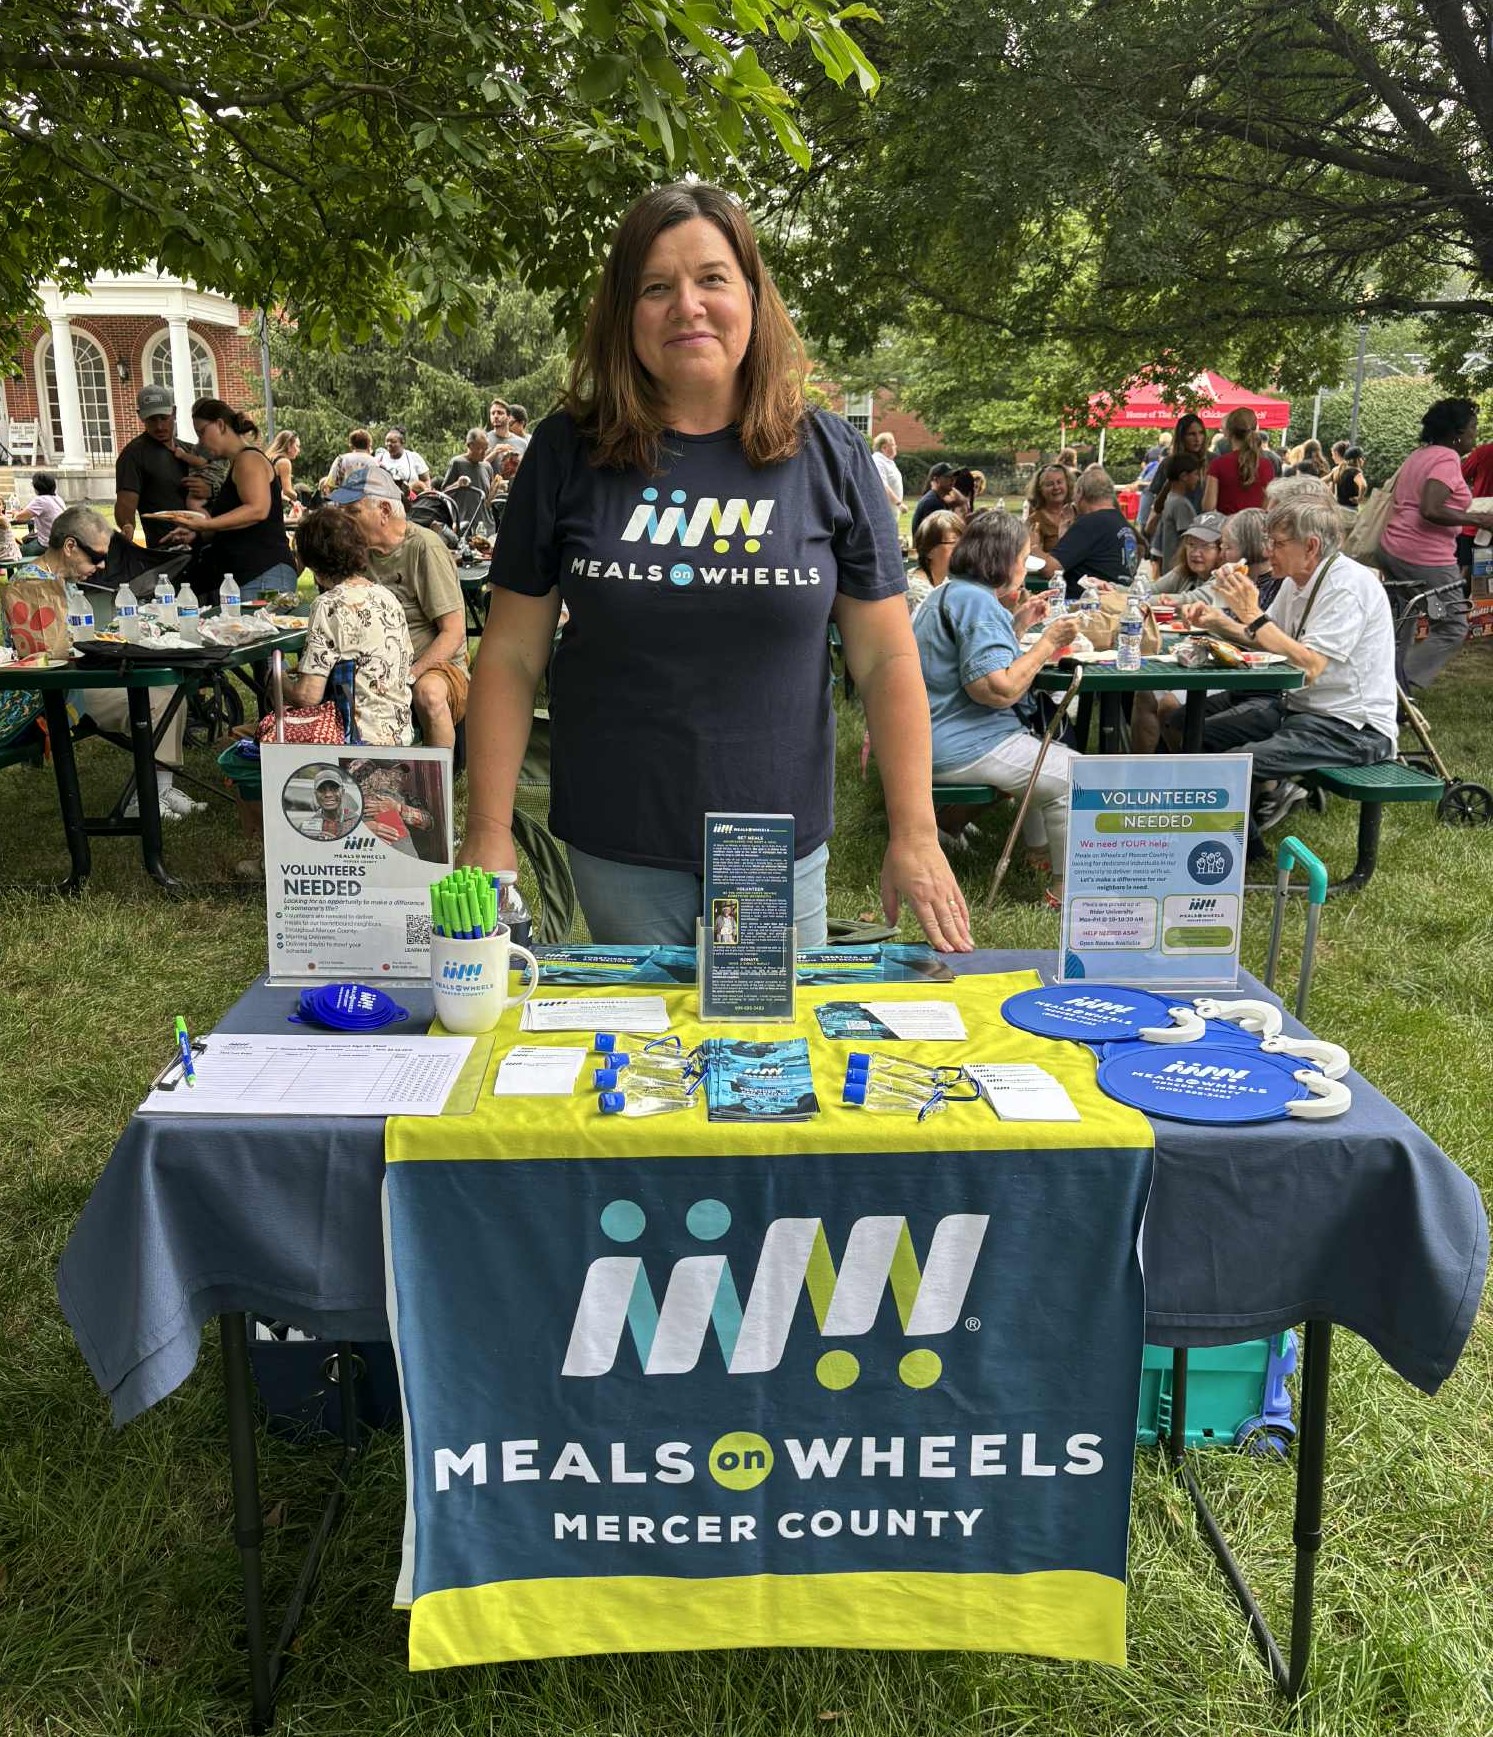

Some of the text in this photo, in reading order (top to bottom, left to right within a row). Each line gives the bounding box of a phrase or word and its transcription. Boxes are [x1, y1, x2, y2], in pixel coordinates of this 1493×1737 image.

[1126, 410, 1147, 418] Home
[1149, 410, 1157, 418] of
[570, 557, 821, 586] MEALS on WHEELS
[1101, 791, 1217, 804] VOLUNTEERS
[1124, 815, 1193, 828] NEEDED
[1080, 840, 1094, 848] We
[1096, 840, 1117, 848] need
[1120, 840, 1146, 848] YOUR
[280, 864, 366, 876] VOLUNTEERS
[284, 879, 362, 896] NEEDED
[1131, 1072, 1268, 1094] MEALS WHEELS
[434, 1433, 1105, 1492] MEALS on WHEELS
[554, 1508, 983, 1543] MERCER COUNTY
